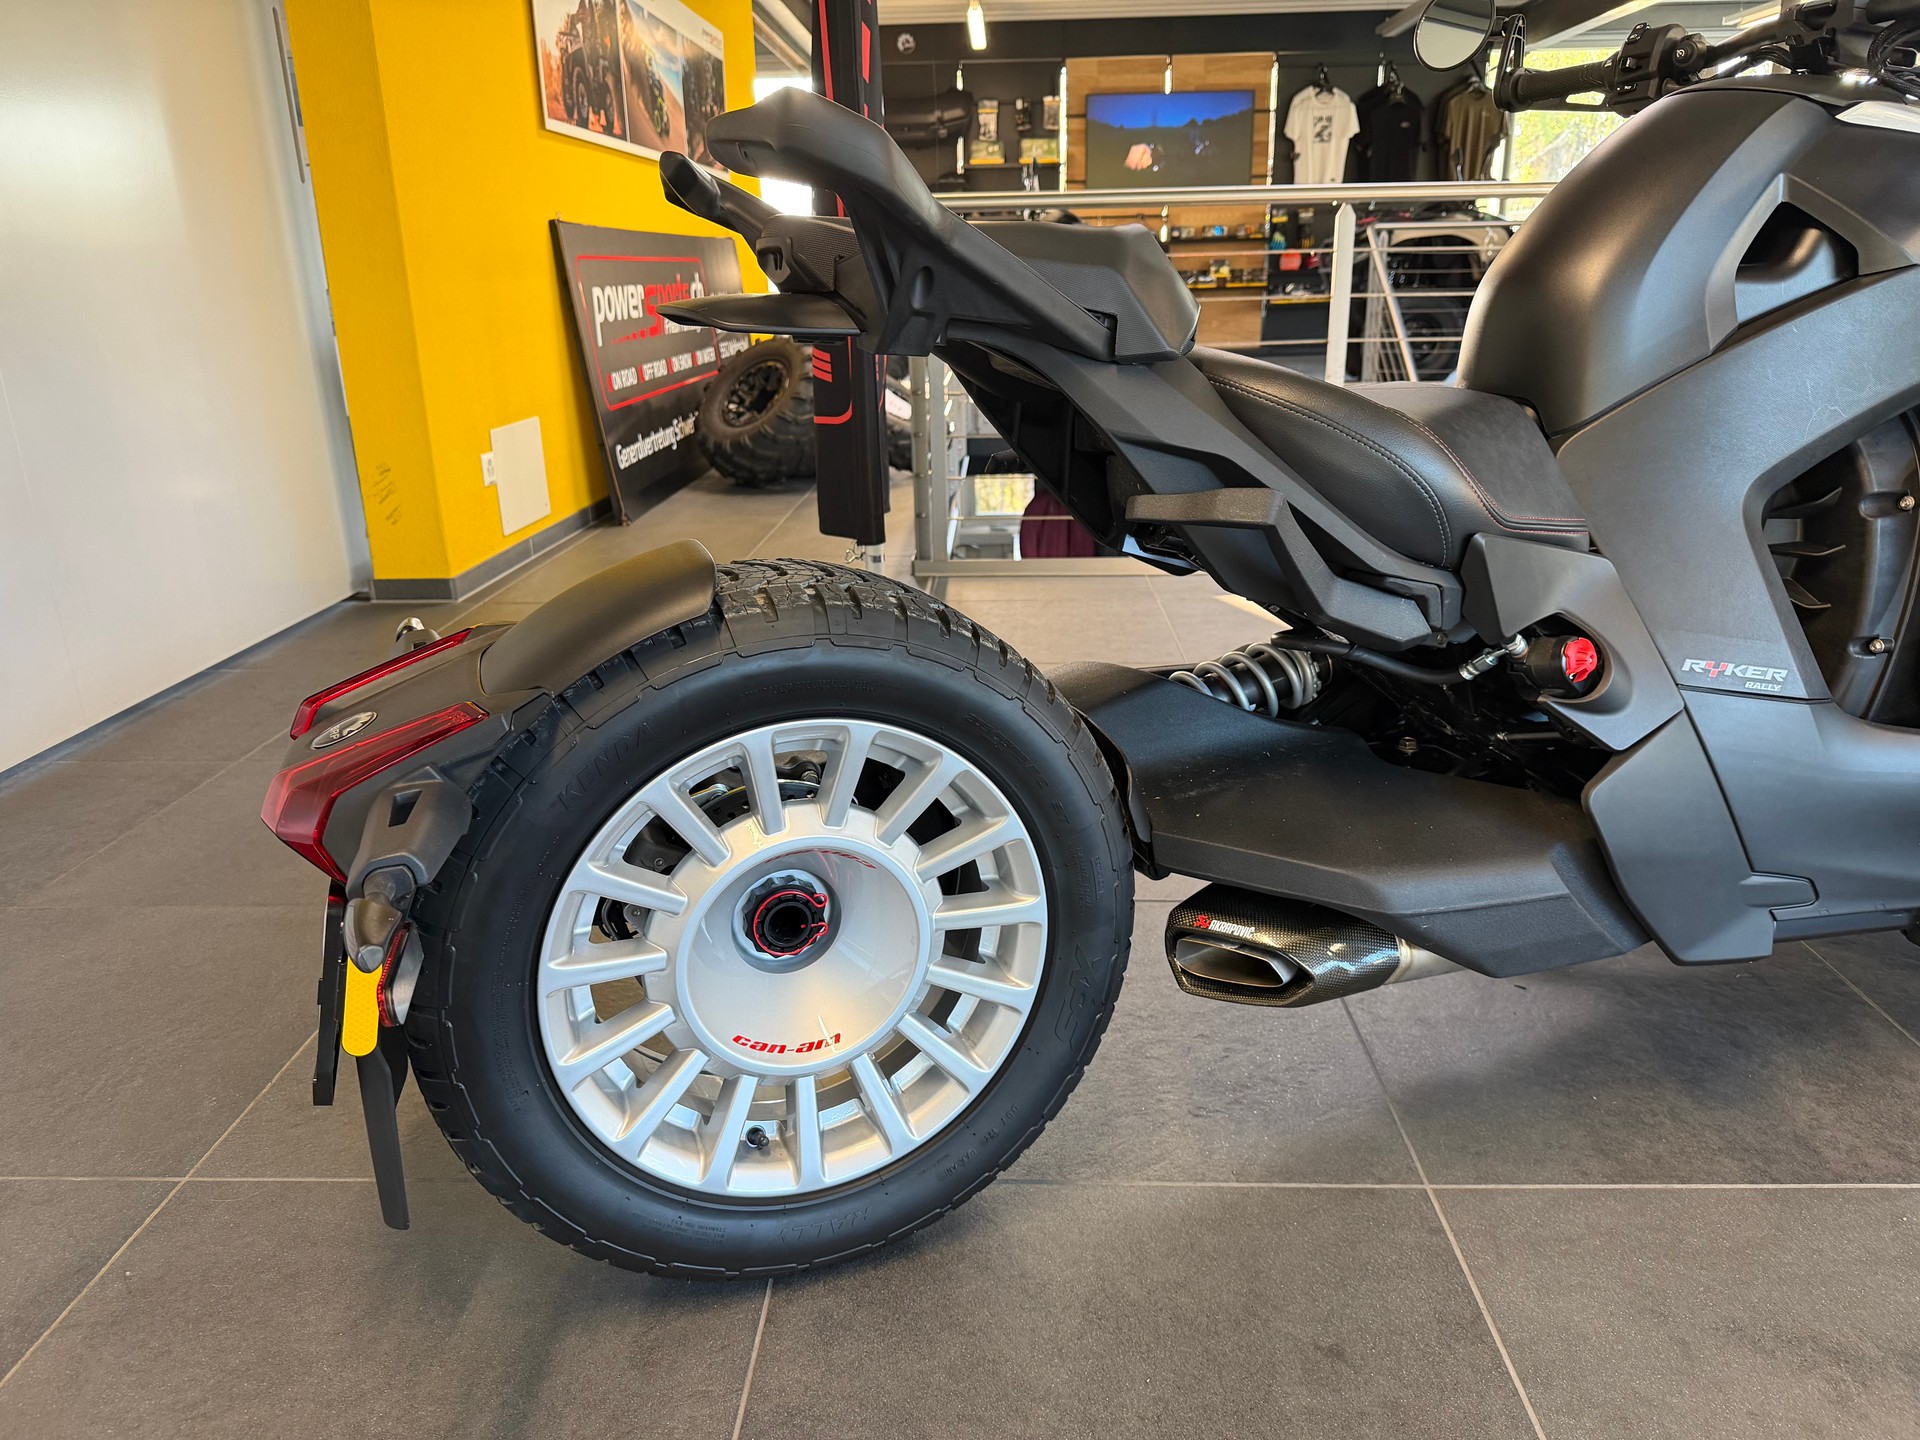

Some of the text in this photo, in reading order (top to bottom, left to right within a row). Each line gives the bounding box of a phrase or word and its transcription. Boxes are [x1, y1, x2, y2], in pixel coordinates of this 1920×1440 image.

[672, 410, 699, 442] Schwei
[1681, 658, 1788, 682] RYKER
[1744, 681, 1782, 692] RALLY
[731, 1033, 841, 1054] can-am
